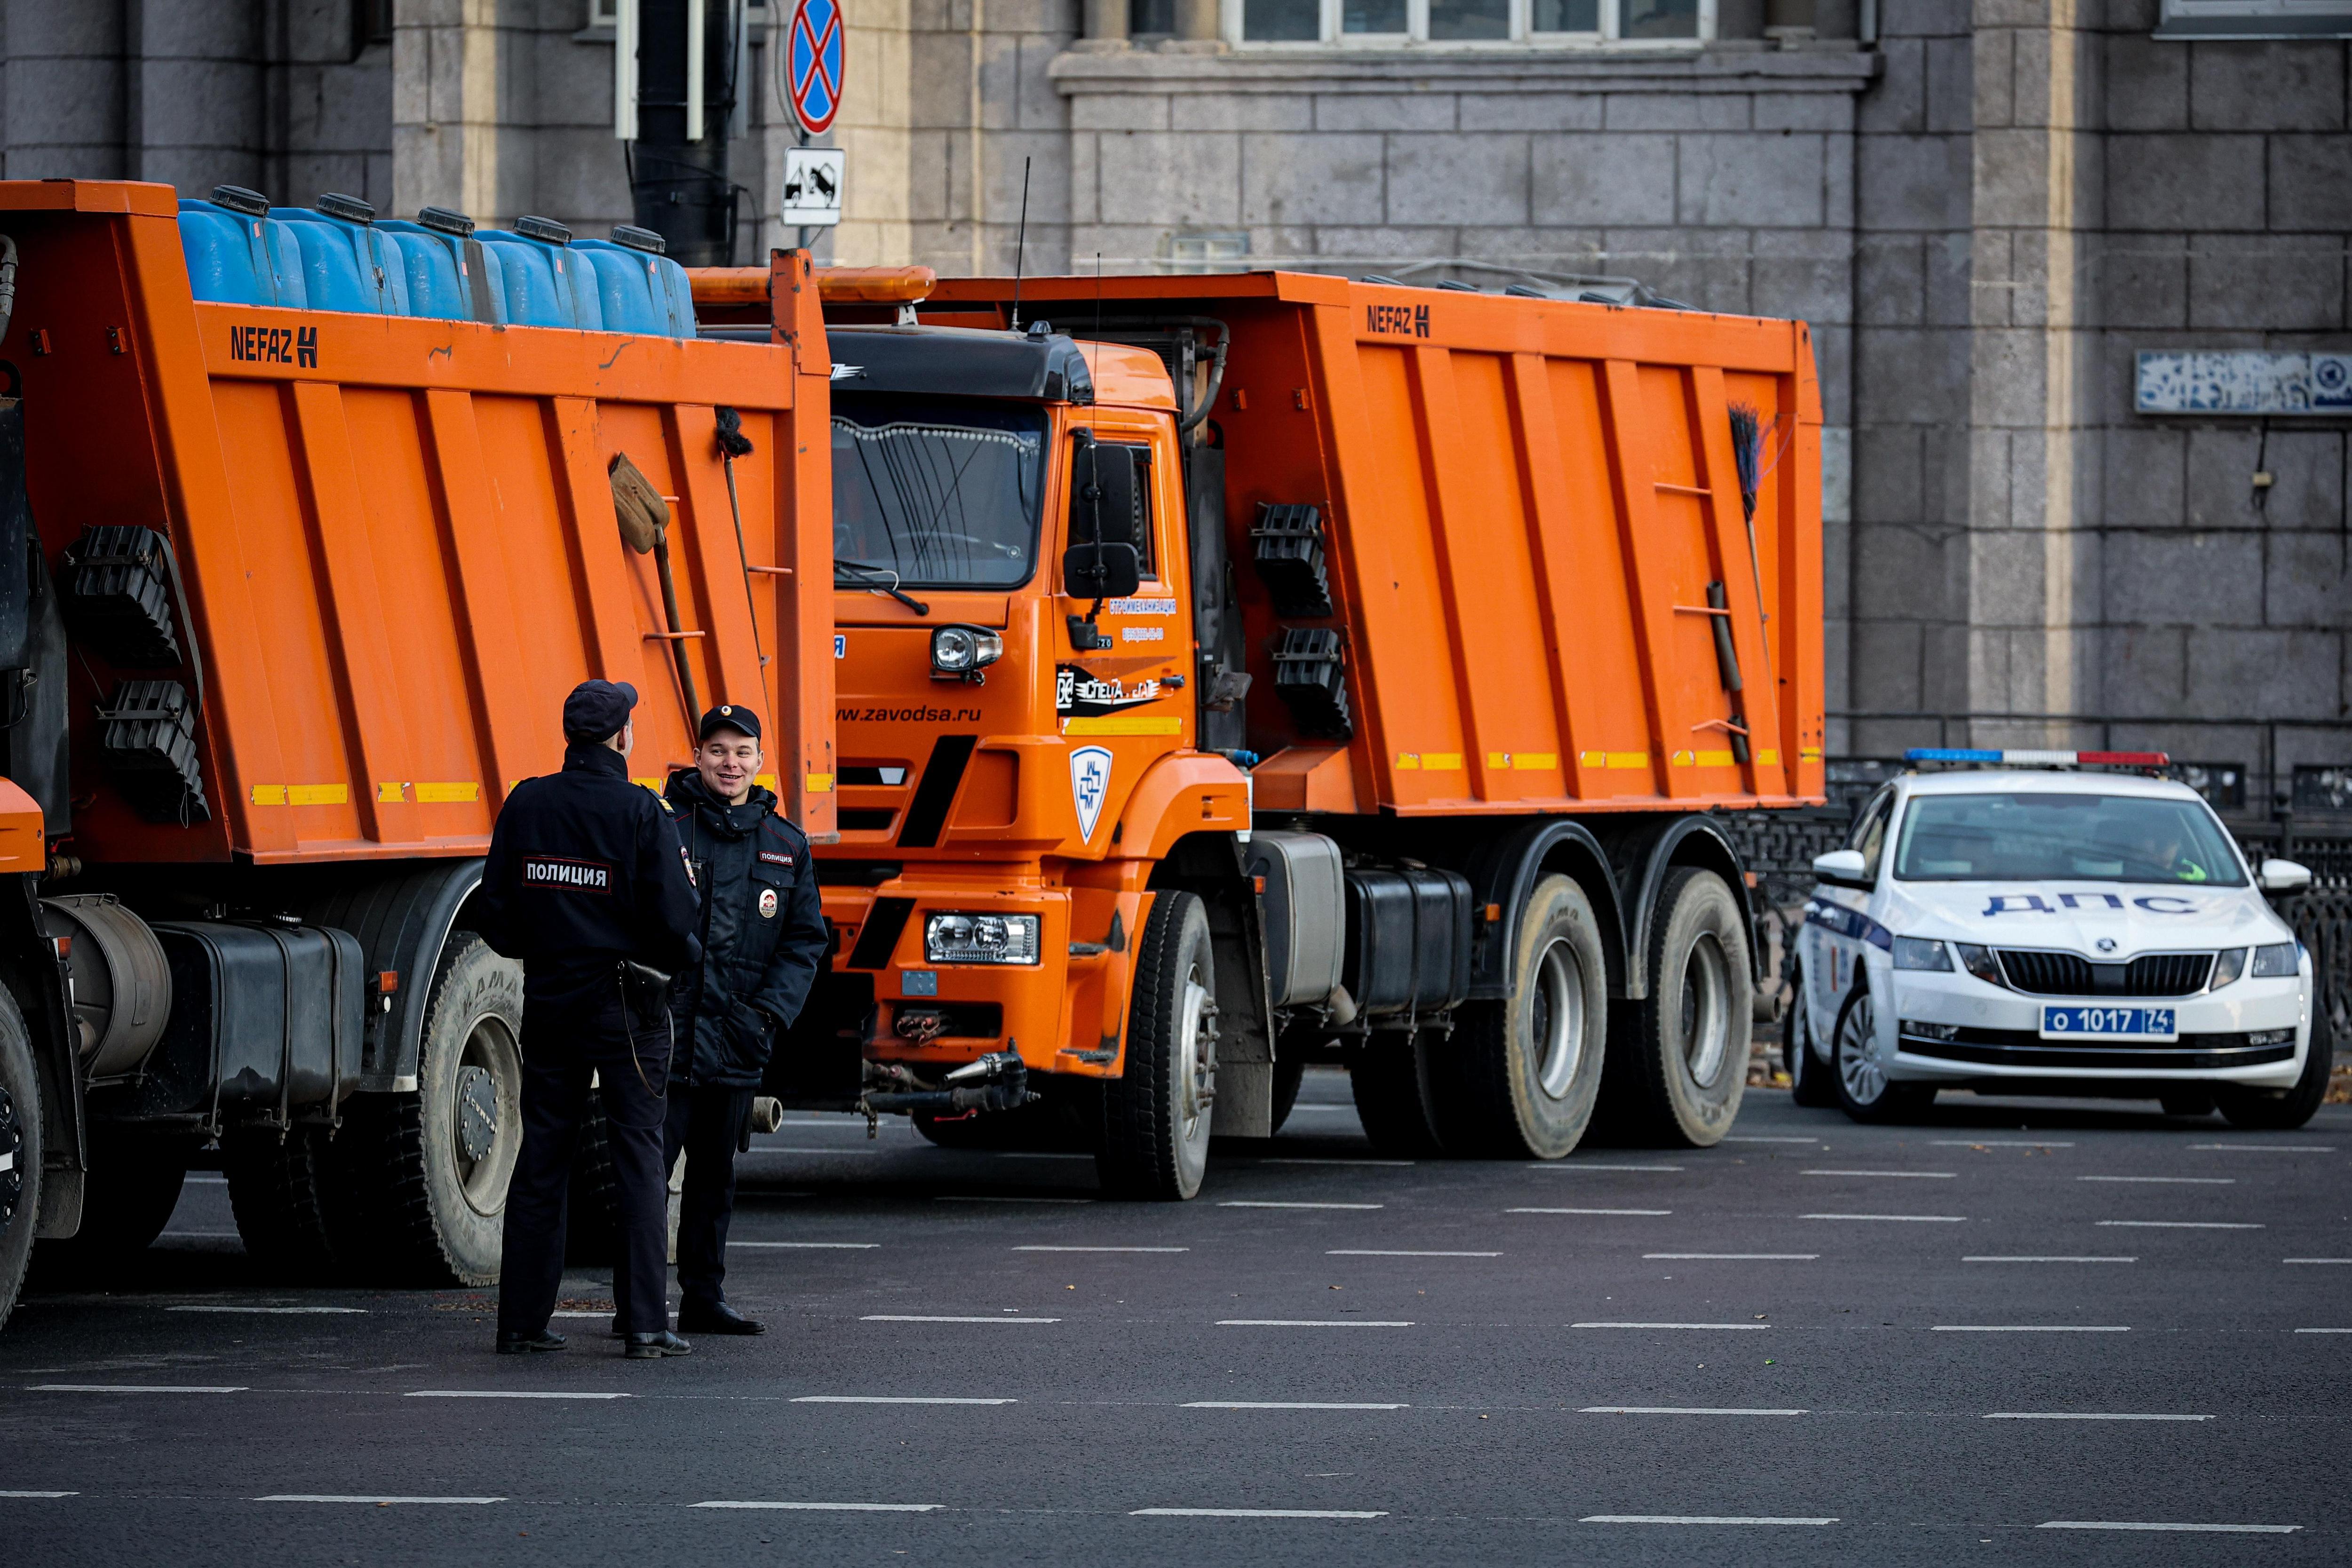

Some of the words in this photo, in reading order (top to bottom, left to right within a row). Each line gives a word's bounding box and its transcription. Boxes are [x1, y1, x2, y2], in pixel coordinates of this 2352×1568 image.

[1367, 305, 1411, 334] NEFAZ
[231, 326, 292, 363] NEFAZ
[762, 853, 792, 863] ПОЛИЦИЯ
[527, 863, 606, 886] ПОЛИЦИЯ
[1982, 893, 2200, 916] ДПС
[2078, 1009, 2132, 1031] 1017
[2146, 1010, 2168, 1027] 74
